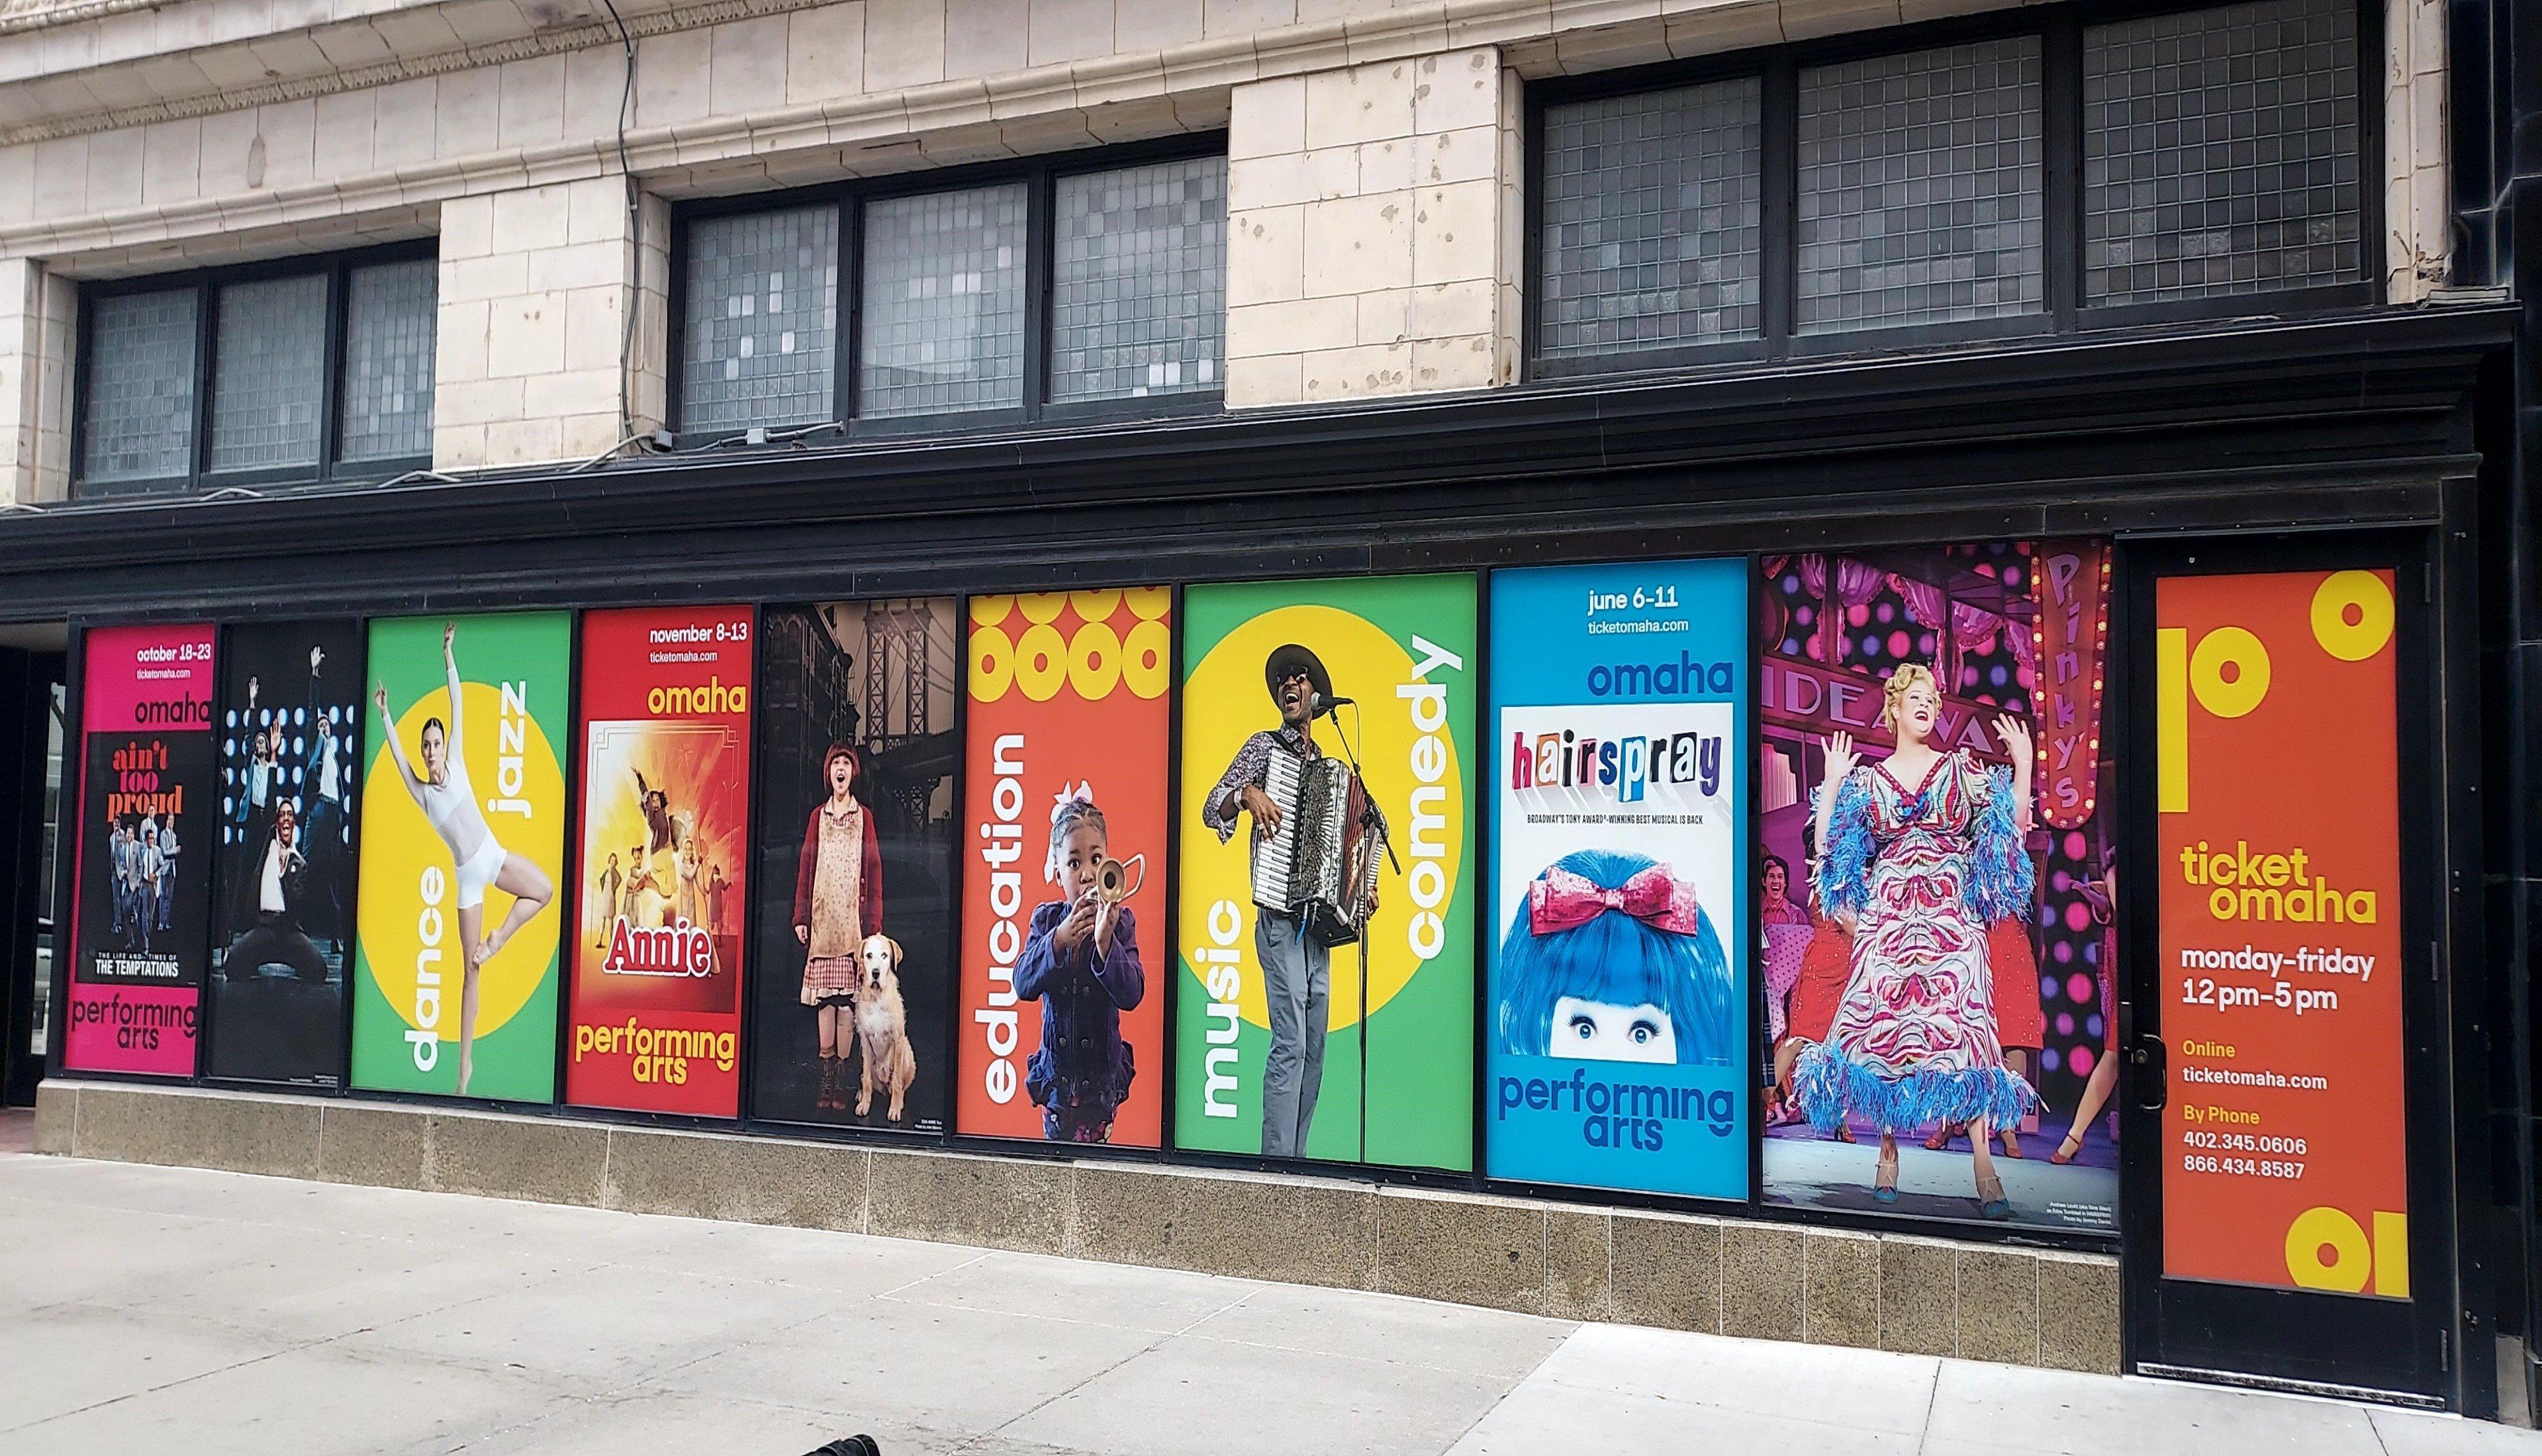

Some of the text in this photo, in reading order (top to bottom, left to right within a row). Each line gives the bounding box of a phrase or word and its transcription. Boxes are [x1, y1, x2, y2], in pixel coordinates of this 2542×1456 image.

[1587, 585, 1679, 616] june 6-11
[649, 622, 747, 644] november 8-13
[1588, 619, 1689, 635] ticketomaha.com
[137, 643, 211, 662] october 18-23
[649, 650, 718, 663] ticketomaha.com
[136, 668, 191, 680] ticketomaha.com
[1587, 650, 1734, 696] omaha
[135, 691, 212, 723] omaha
[648, 676, 746, 713] omaha
[113, 741, 167, 770] ain't
[488, 680, 532, 819] jazz
[120, 768, 158, 793] too
[1511, 729, 1722, 803] hairspray
[107, 785, 182, 823] proud
[1396, 633, 1463, 961] comedy
[1527, 814, 1565, 825] BROADWAY'S
[1566, 814, 1581, 825] TONY
[1636, 815, 1650, 825] BEST
[1652, 815, 1678, 825] MUSICAL
[1679, 815, 1685, 825] IS
[1687, 815, 1703, 825] BACK
[2180, 841, 2309, 887] ticket
[2209, 876, 2377, 924] omaha
[974, 733, 1025, 1105] education
[603, 916, 711, 976] Annie
[95, 959, 179, 977] THE TEMPTATIONS
[404, 866, 446, 1073] dance
[71, 993, 197, 1038] performing
[1194, 899, 1243, 1119] music
[117, 1026, 160, 1050] arts
[575, 1017, 735, 1072] performing
[2183, 1040, 2236, 1058] Online
[632, 1054, 688, 1085] arts
[2183, 1066, 2328, 1089] ticketomaha.com
[1498, 1068, 1734, 1138] performing
[2184, 1105, 2260, 1125] By Phone
[1583, 1115, 1664, 1152] arts
[2183, 1131, 2306, 1155] 402.345.0606
[2184, 1155, 2305, 1179] 866.434.8587
